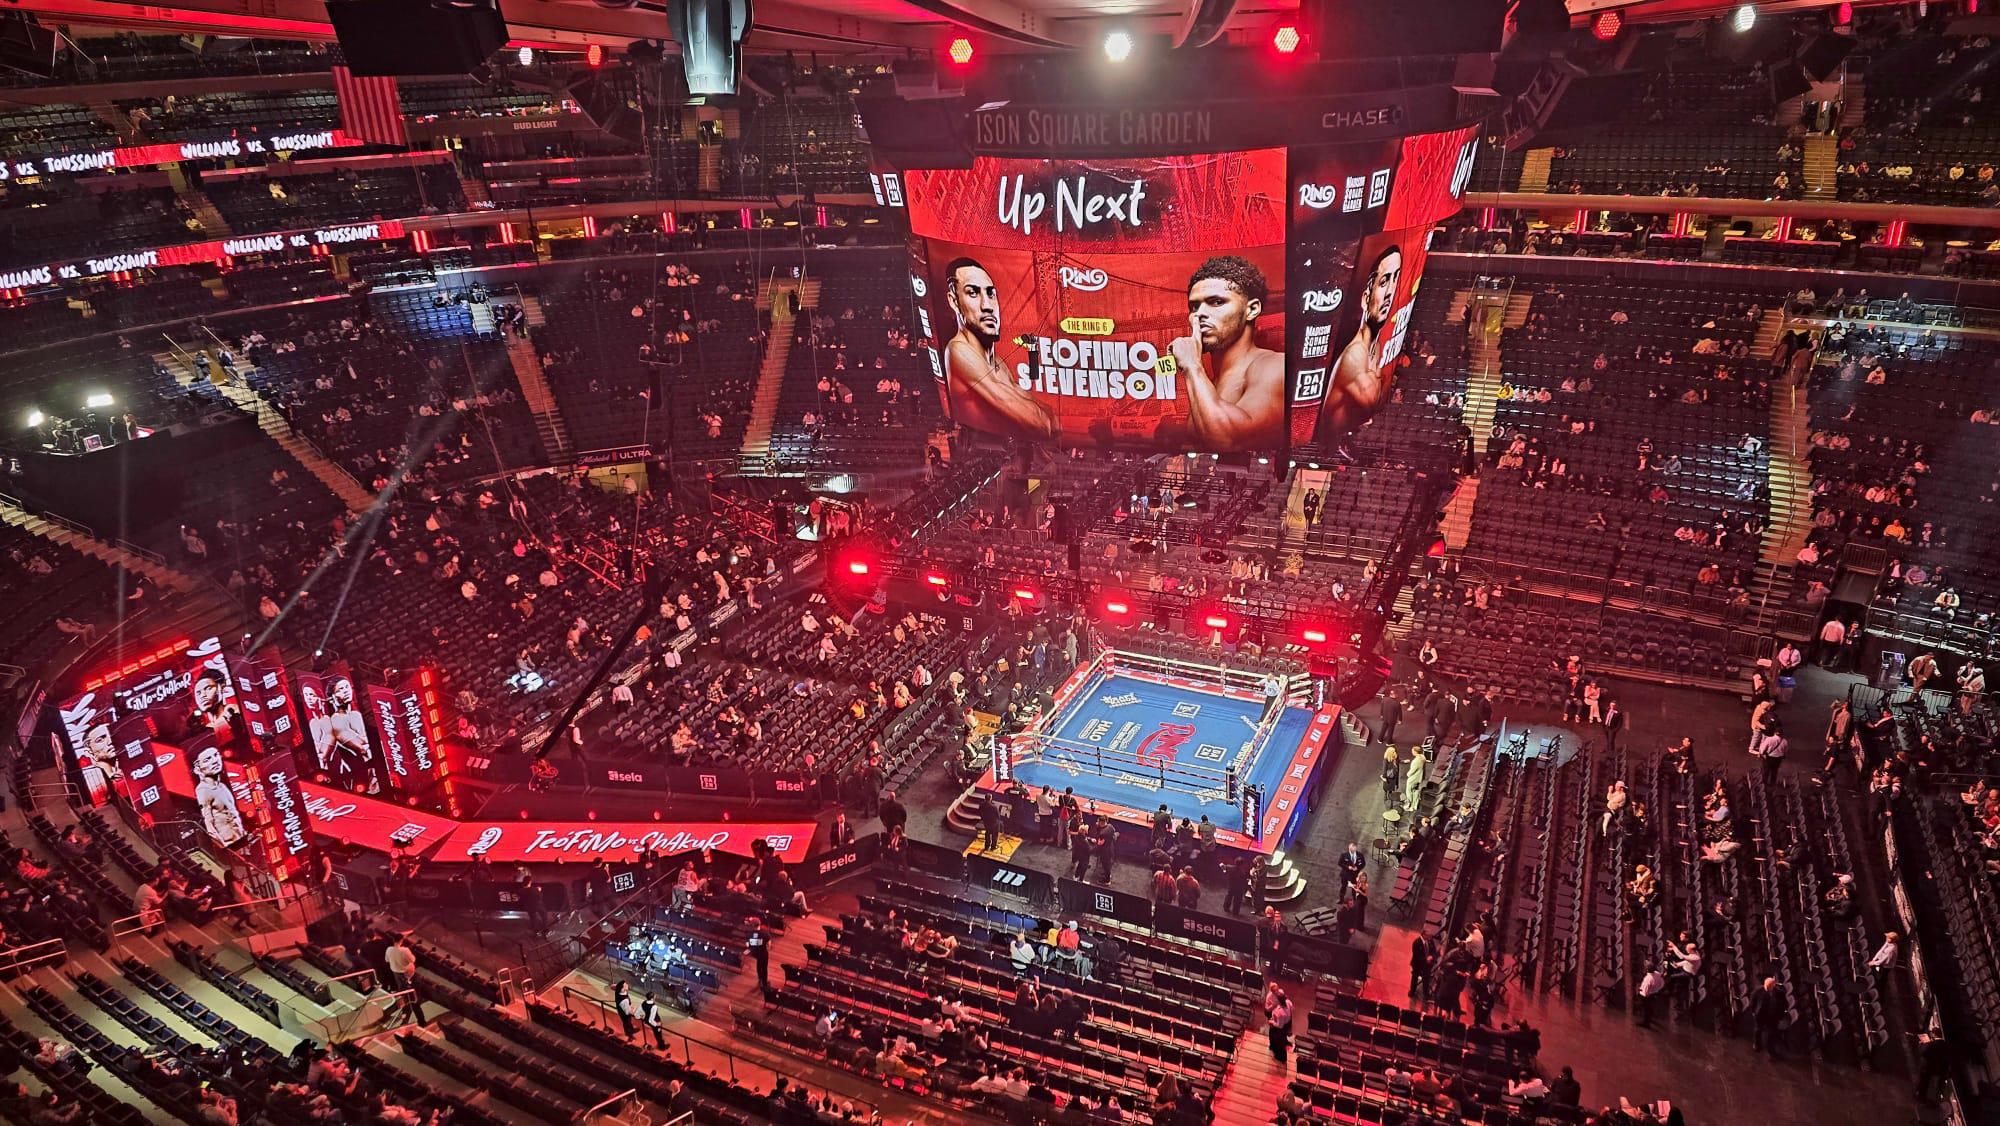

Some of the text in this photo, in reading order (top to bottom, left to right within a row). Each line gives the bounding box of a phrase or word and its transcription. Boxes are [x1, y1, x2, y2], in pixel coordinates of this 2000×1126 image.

[513, 120, 558, 130] BUD LIGHT
[1322, 108, 1389, 128] CHASE
[977, 109, 1211, 145] ISON SQUARE GARDEN
[180, 139, 241, 159] WILLIAMS
[270, 132, 333, 151] TOUSSAINT
[43, 150, 115, 173] TOUSSAINT
[997, 173, 1146, 235] Up Next
[223, 234, 285, 255] WILLIAMS
[314, 224, 379, 244] TOUSSAINT
[85, 251, 157, 274] TOUSSAINT
[1067, 320, 1107, 331] THE RING 6
[1305, 325, 1332, 337] MADISON
[1304, 336, 1330, 347] SQUARE
[1031, 336, 1158, 371] EOFIMO
[1302, 346, 1328, 357] GARDEN
[1158, 359, 1175, 373] VS.
[1017, 362, 1177, 400] STEVENSON
[620, 449, 652, 459] ULTRA
[619, 771, 643, 783] sela
[787, 781, 804, 792] sel
[831, 852, 856, 870] sela
[1196, 923, 1226, 938] sela
